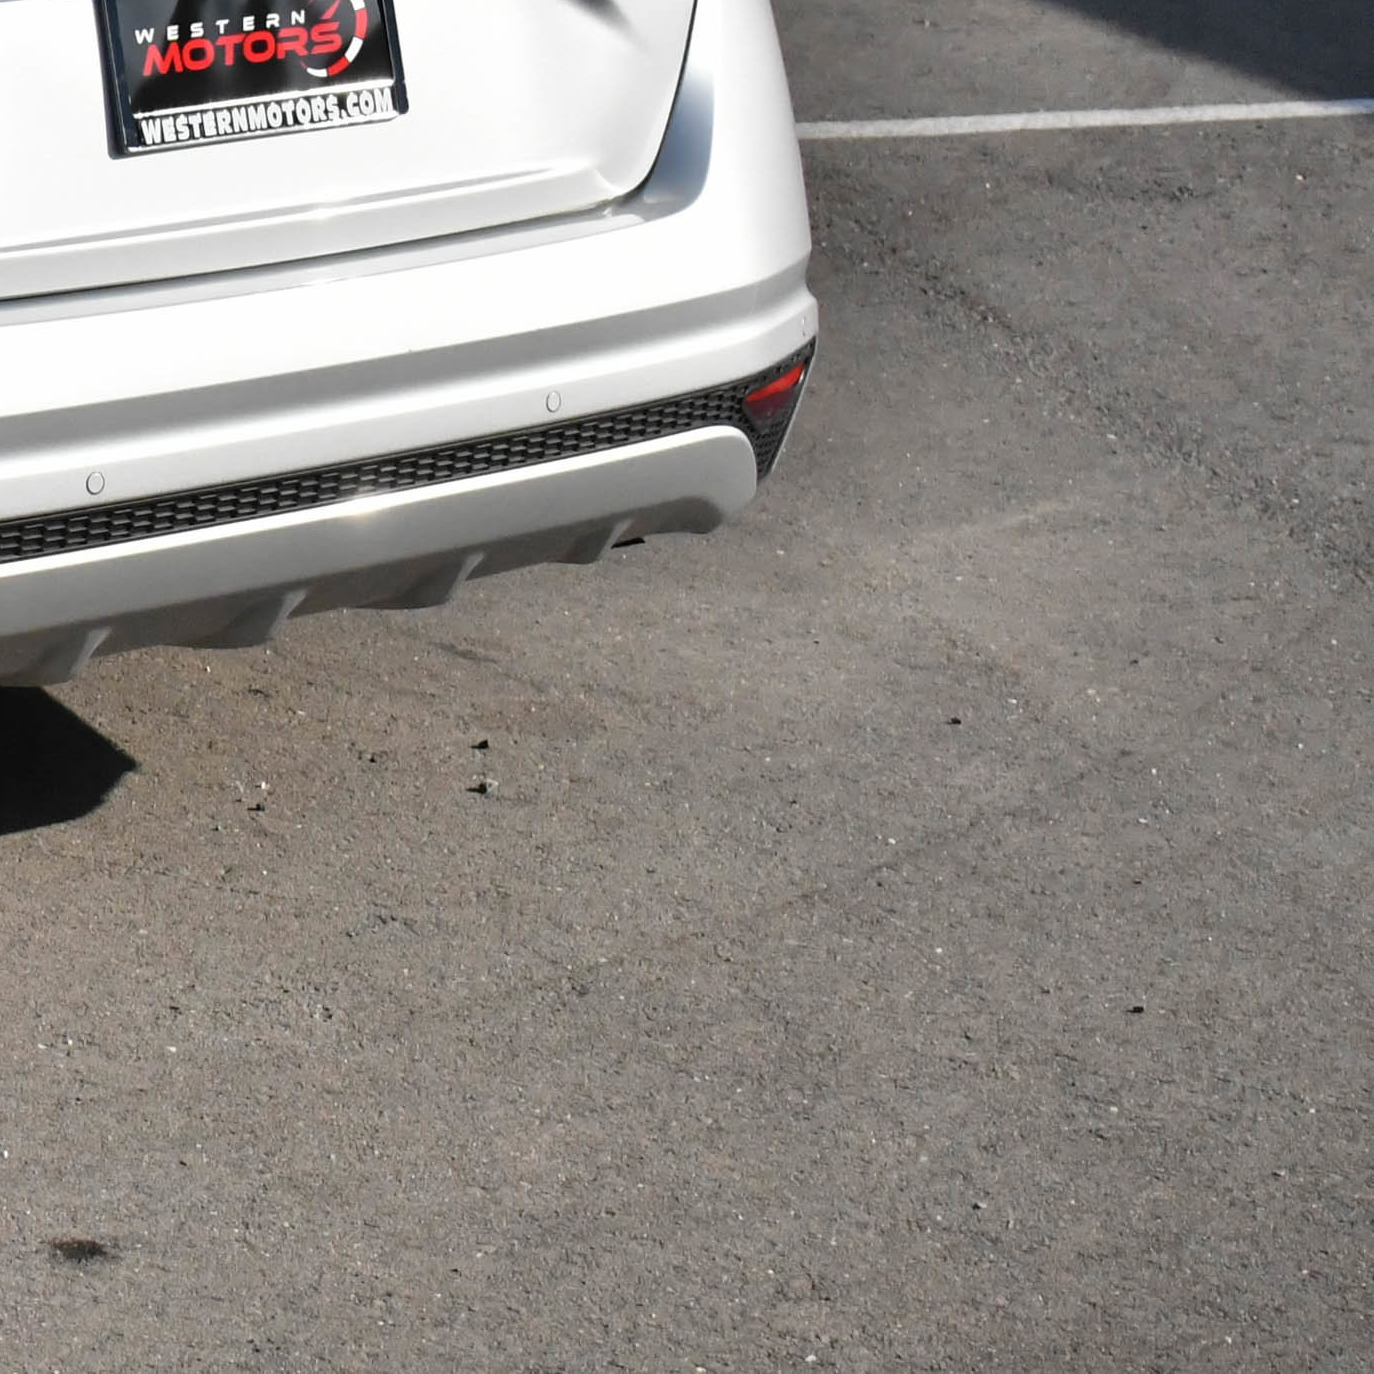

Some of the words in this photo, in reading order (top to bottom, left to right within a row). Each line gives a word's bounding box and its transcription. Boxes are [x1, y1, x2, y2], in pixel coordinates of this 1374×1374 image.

[135, 9, 306, 44] WESTERN
[142, 22, 345, 77] MOTORS
[140, 87, 395, 146] WESTERNMOTORS.COM
